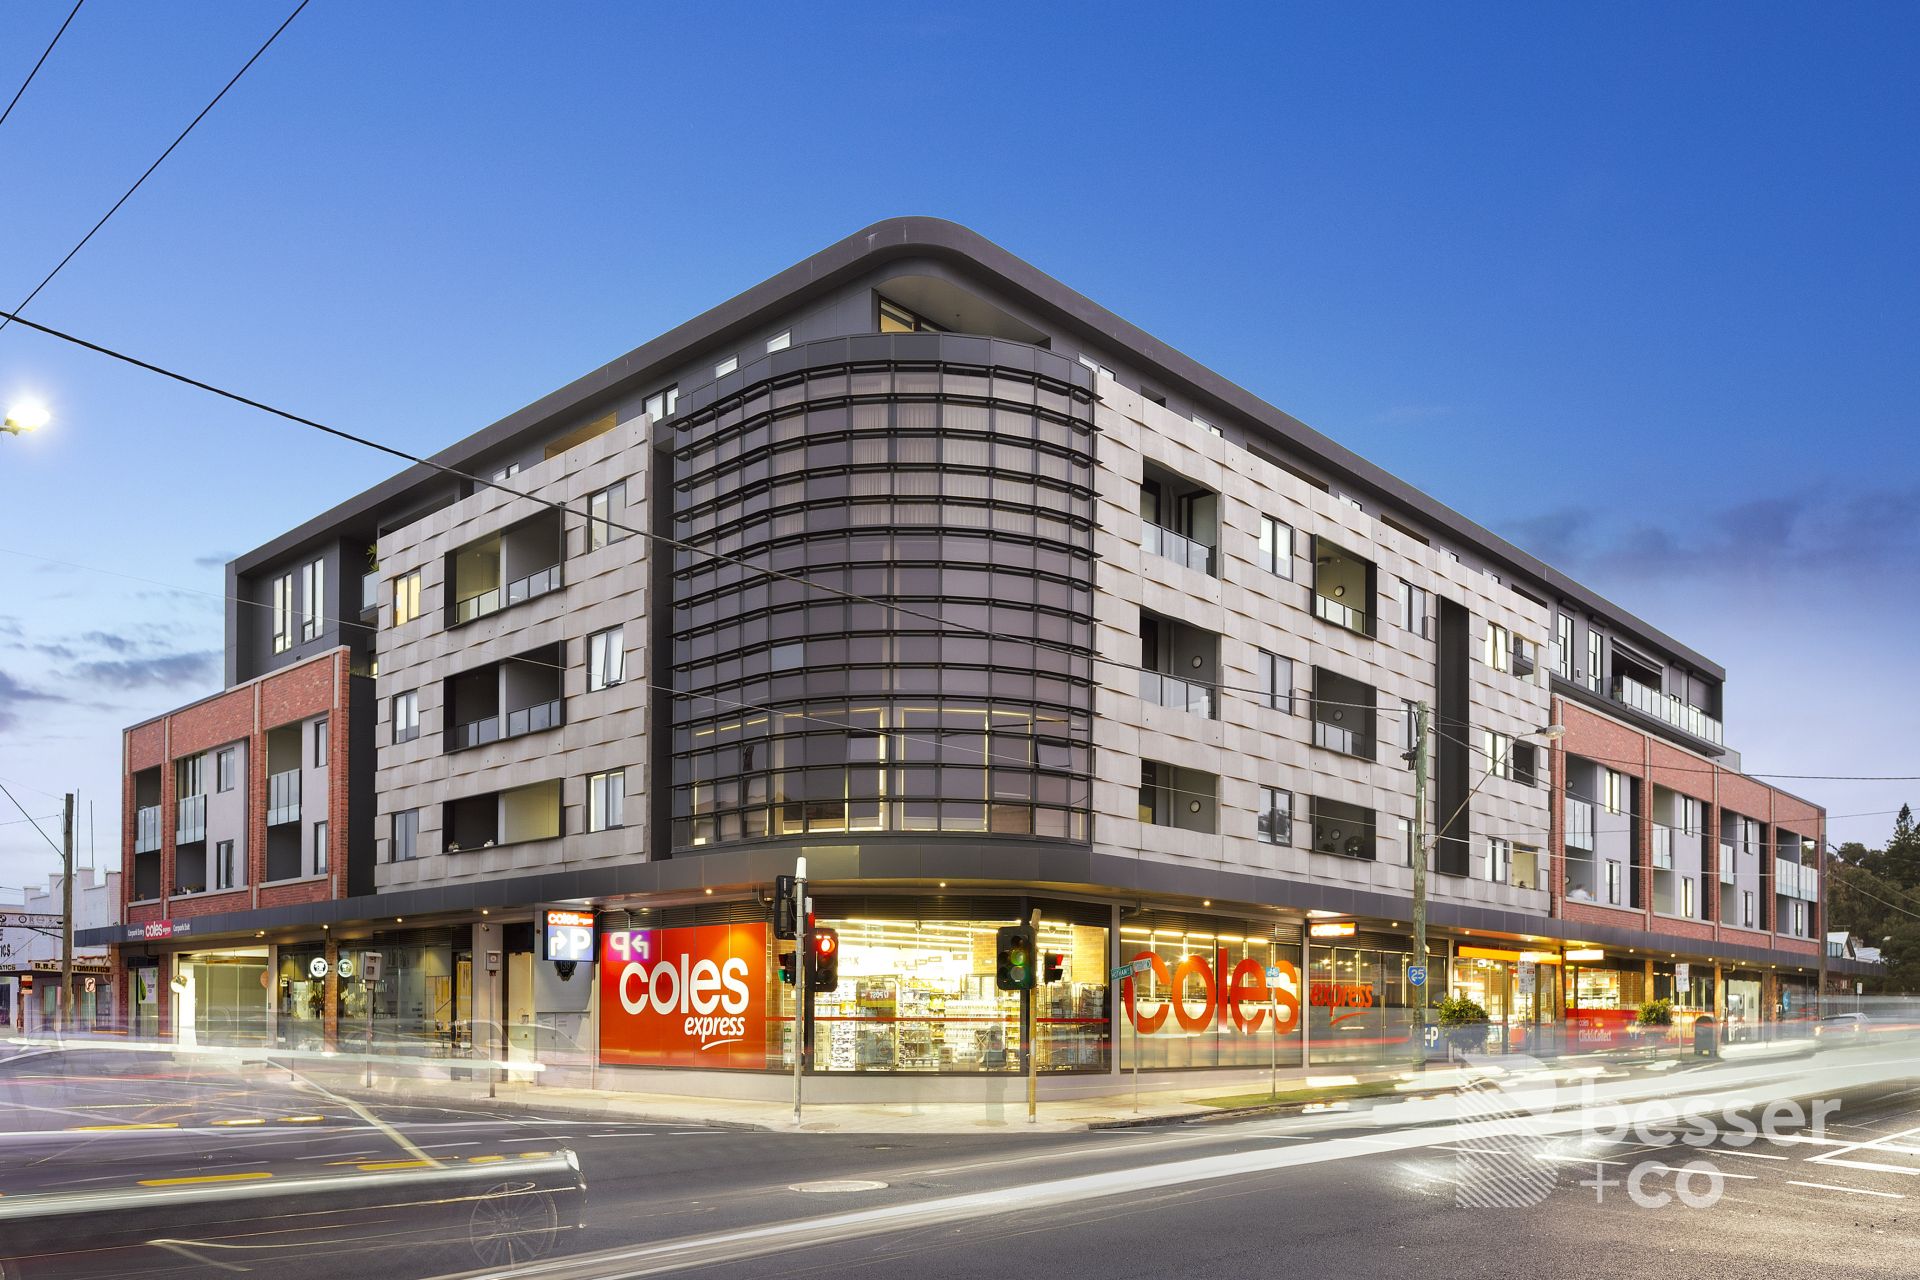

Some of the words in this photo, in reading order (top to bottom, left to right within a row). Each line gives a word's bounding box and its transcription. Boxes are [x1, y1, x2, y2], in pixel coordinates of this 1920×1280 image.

[145, 921, 162, 937] coles
[571, 928, 591, 960] P
[35, 962, 58, 971] B.B.E.
[72, 964, 110, 973] TOMATICS
[1411, 969, 1425, 980] 25
[619, 953, 749, 1015] coles
[1124, 947, 1298, 1035] coles
[1311, 983, 1373, 1017] express
[684, 1014, 745, 1043] express
